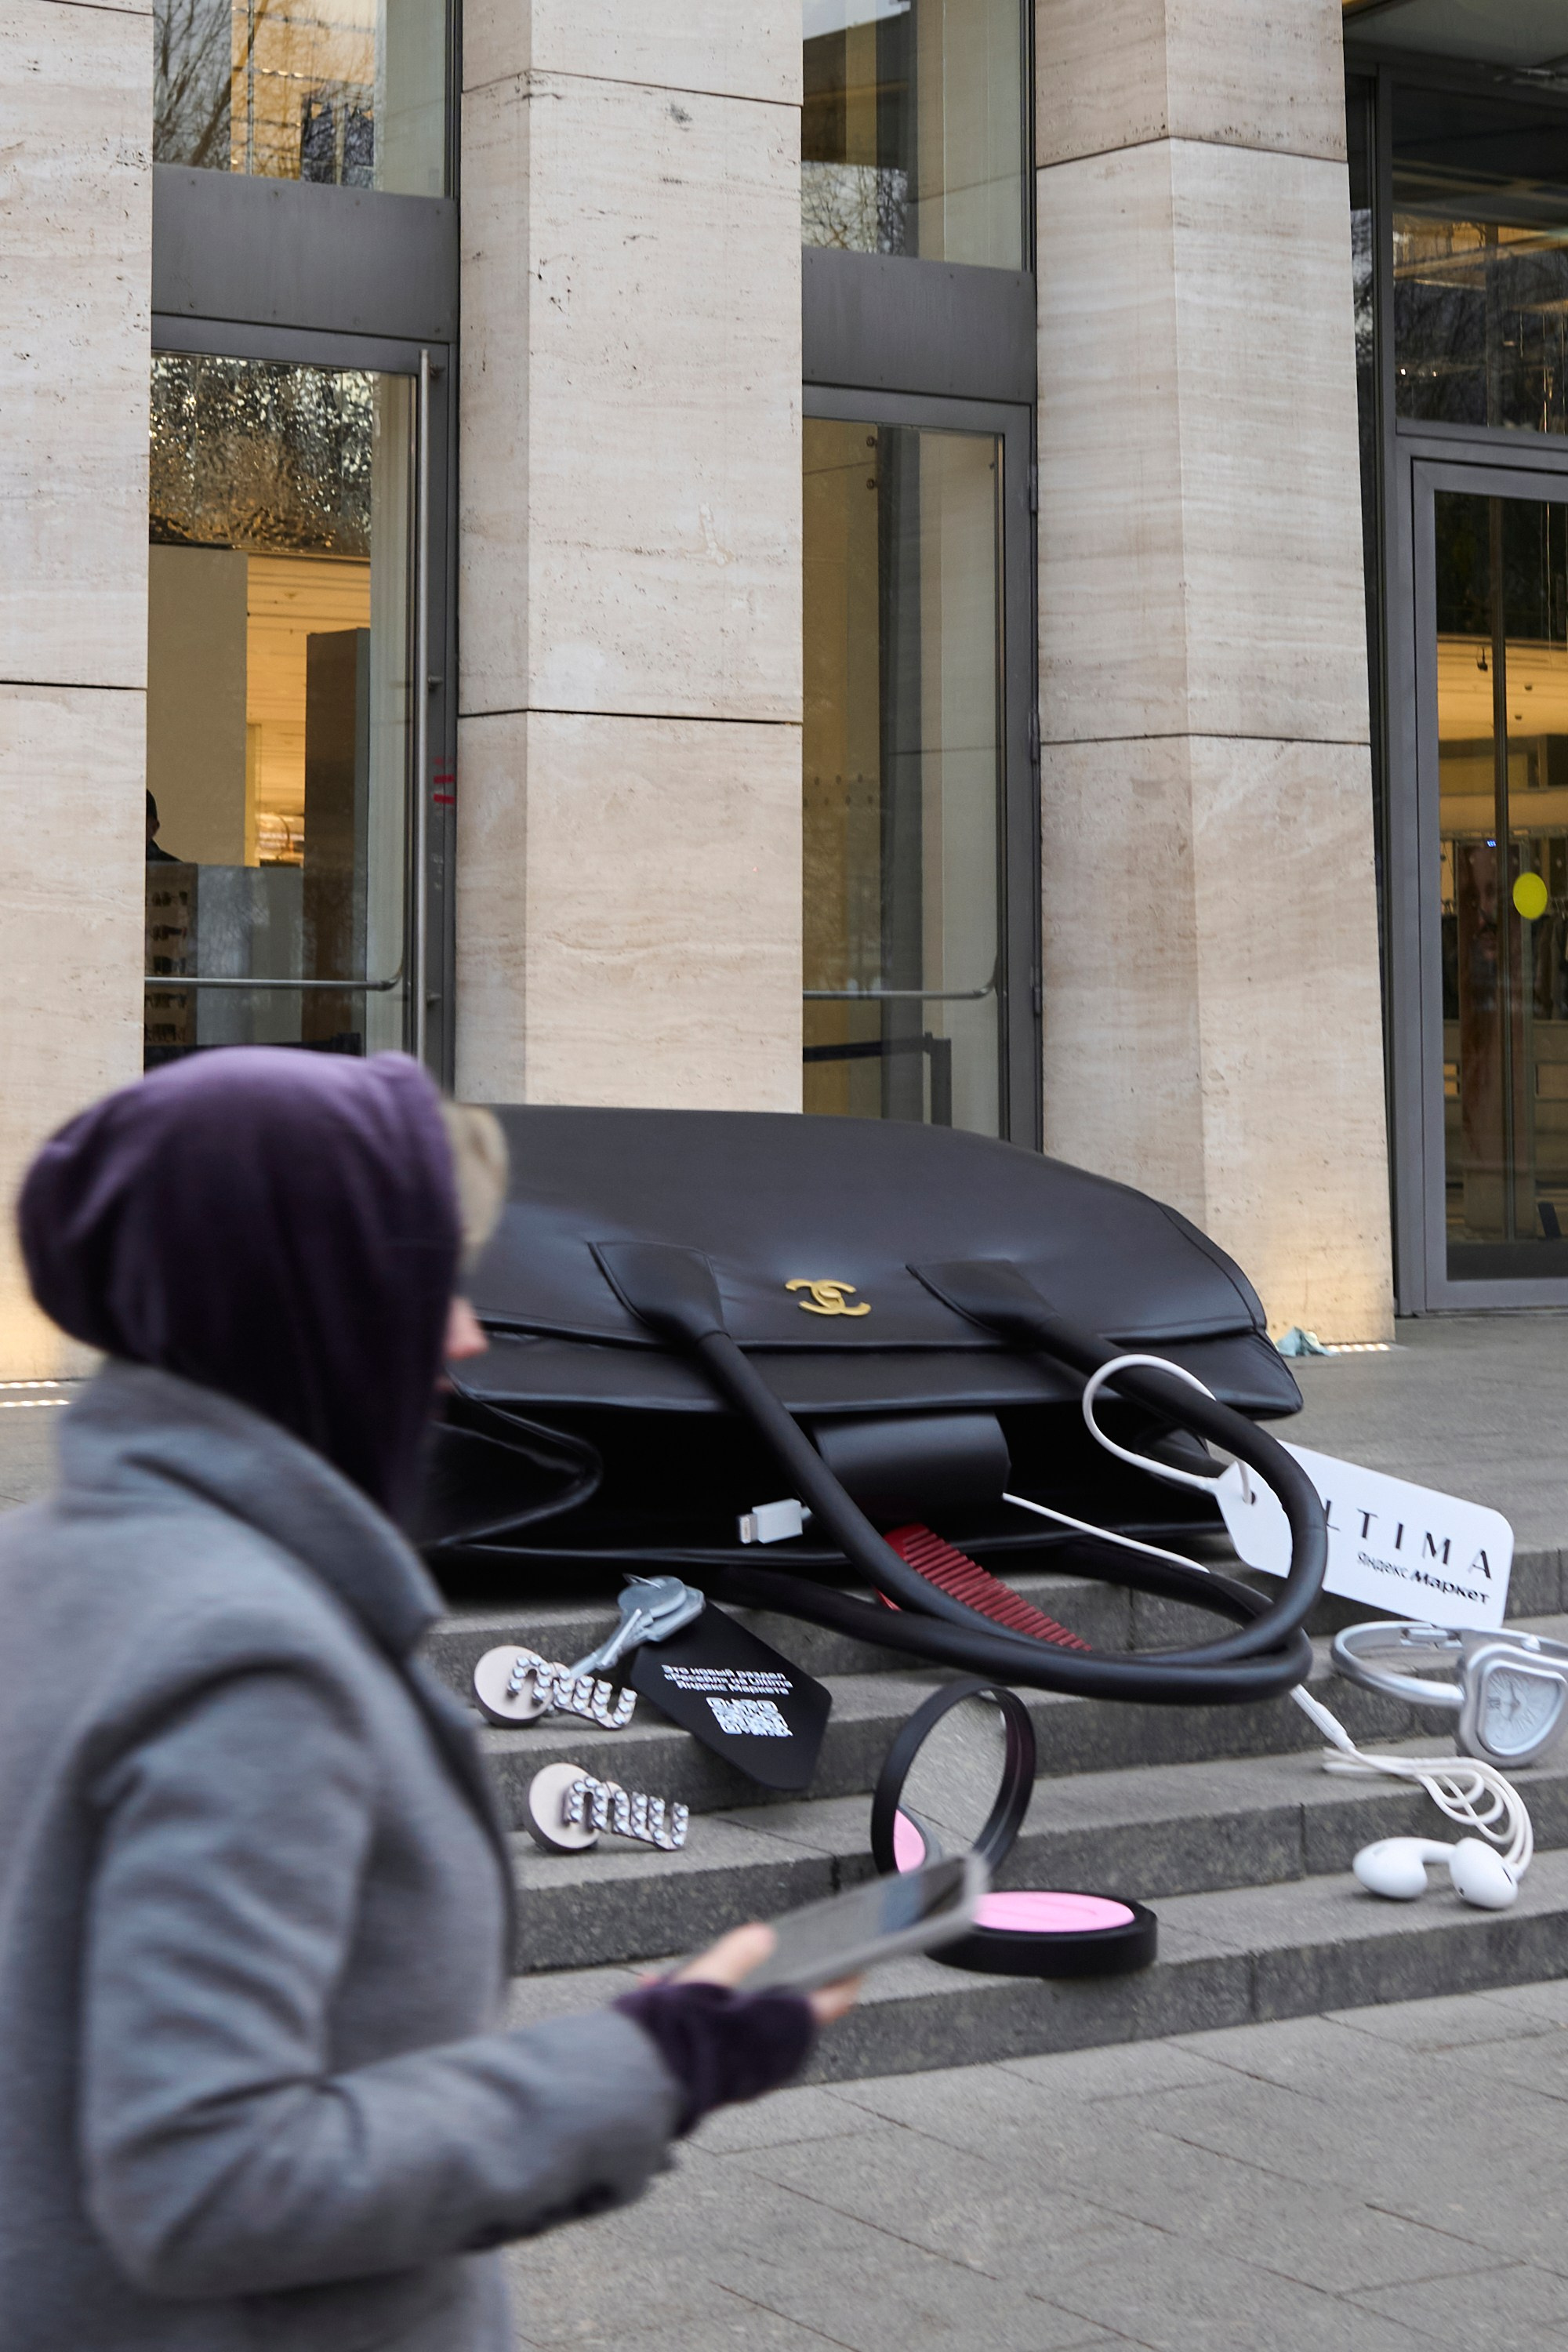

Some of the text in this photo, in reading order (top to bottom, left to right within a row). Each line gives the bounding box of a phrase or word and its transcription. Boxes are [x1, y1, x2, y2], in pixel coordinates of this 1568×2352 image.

[1325, 1499, 1492, 1580] LTIMA
[1410, 1569, 1490, 1604] Маркет
[662, 1664, 786, 1681] Это новый раздел
[730, 1677, 748, 1686] на
[748, 1676, 793, 1688] Ultima
